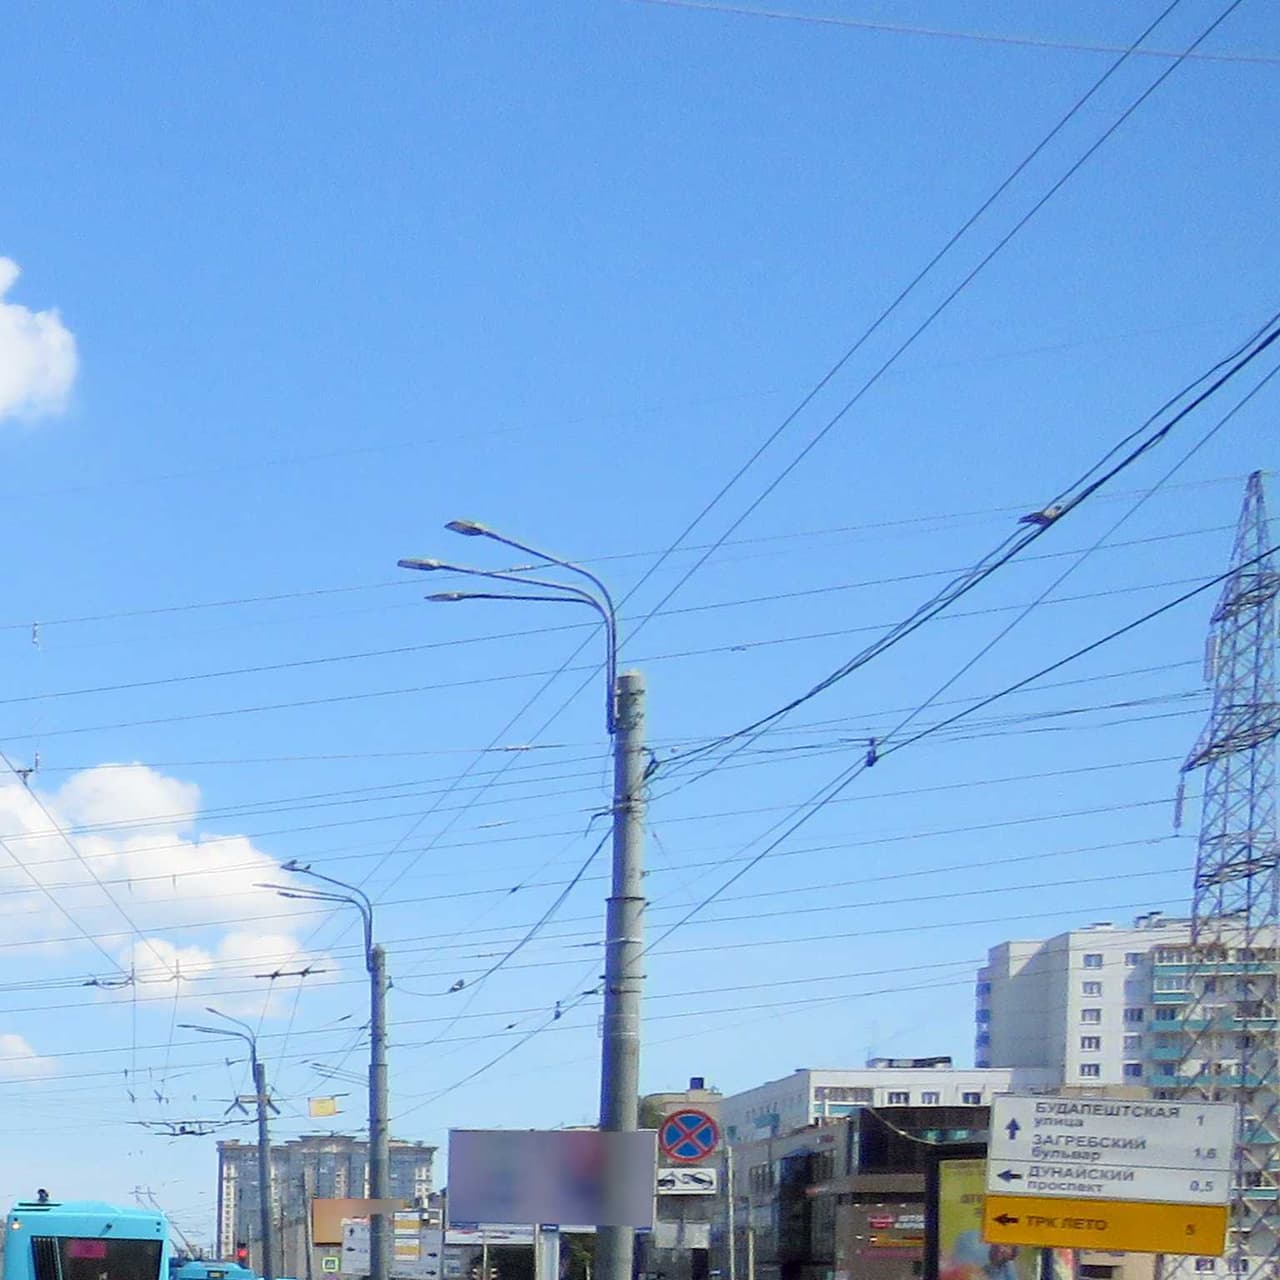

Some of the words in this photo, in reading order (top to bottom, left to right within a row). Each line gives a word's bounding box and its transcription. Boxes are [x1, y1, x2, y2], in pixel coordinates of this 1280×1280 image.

[1035, 1101, 1181, 1119] БУДАПЕШТСКАЯ
[1196, 1114, 1205, 1126] 1
[1033, 1117, 1084, 1128] улица
[1032, 1134, 1147, 1149] ЗАГРЕБСКИЙ
[1031, 1146, 1101, 1160] бульвар
[1029, 1165, 1135, 1182] ДУНАЙСКИЙ
[1027, 1180, 1104, 1194] проспект
[1026, 1214, 1055, 1229] ТРК
[1061, 1217, 1108, 1231] ЛЕТО
